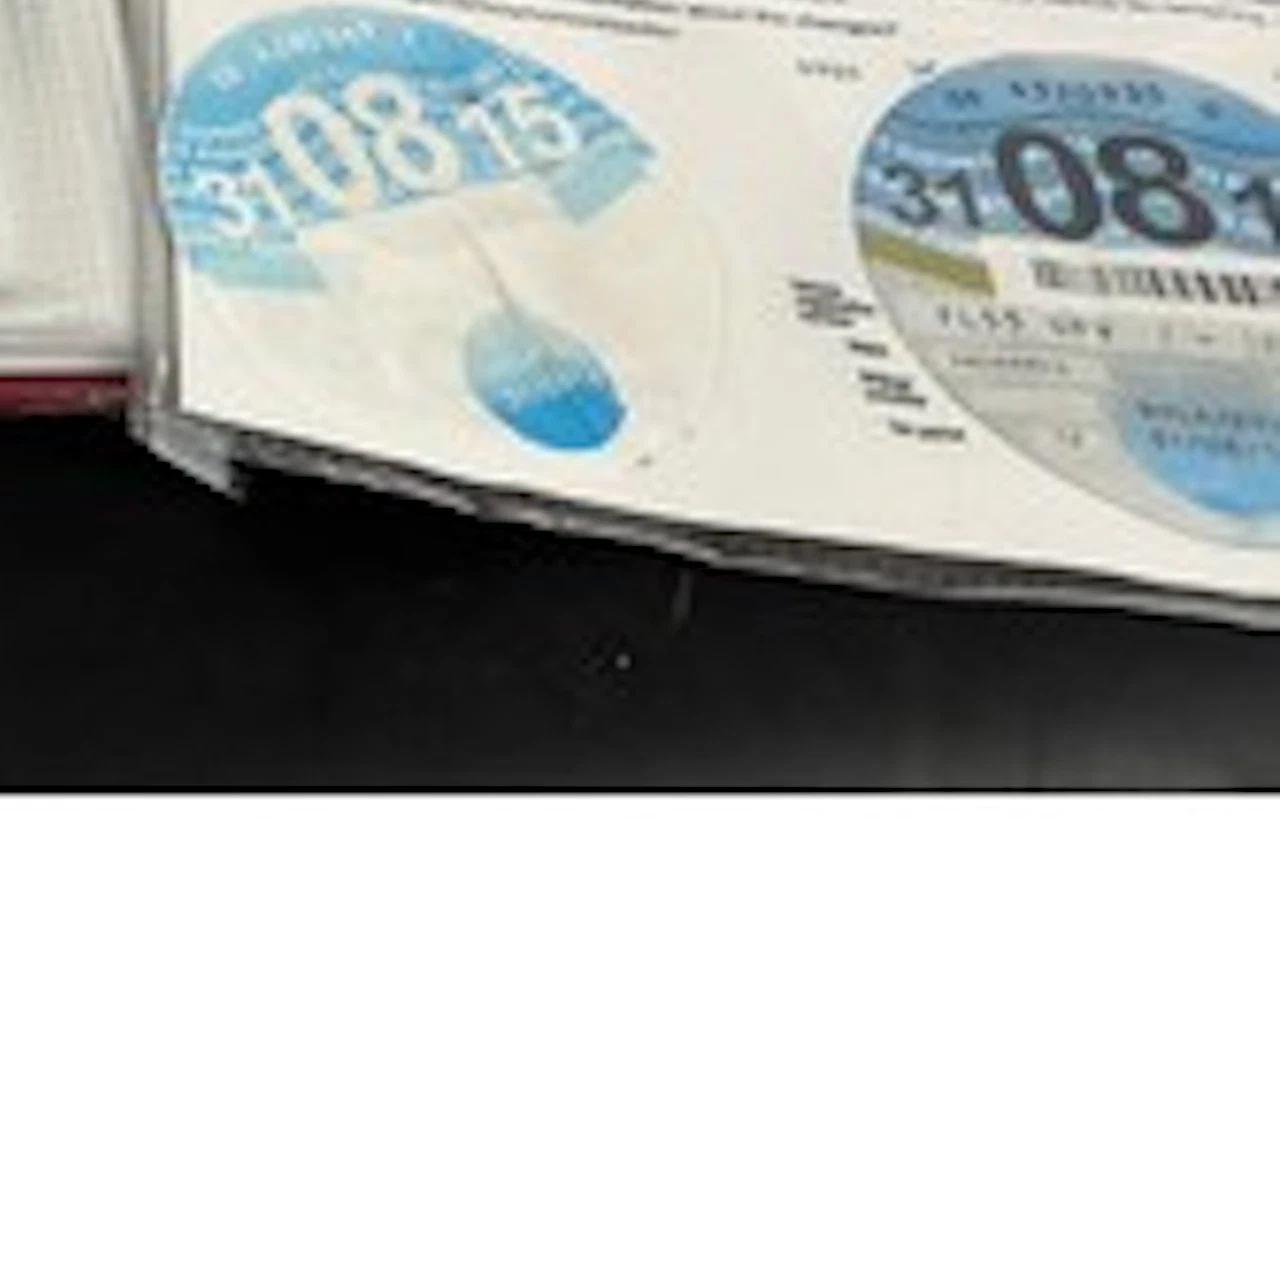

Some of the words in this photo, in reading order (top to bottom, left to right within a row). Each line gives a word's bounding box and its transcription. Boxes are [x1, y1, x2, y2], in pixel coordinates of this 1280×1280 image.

[196, 158, 300, 240] 31
[263, 69, 460, 208] 08
[454, 79, 582, 168] 15
[881, 159, 984, 229] 31
[993, 120, 1217, 248] 08
